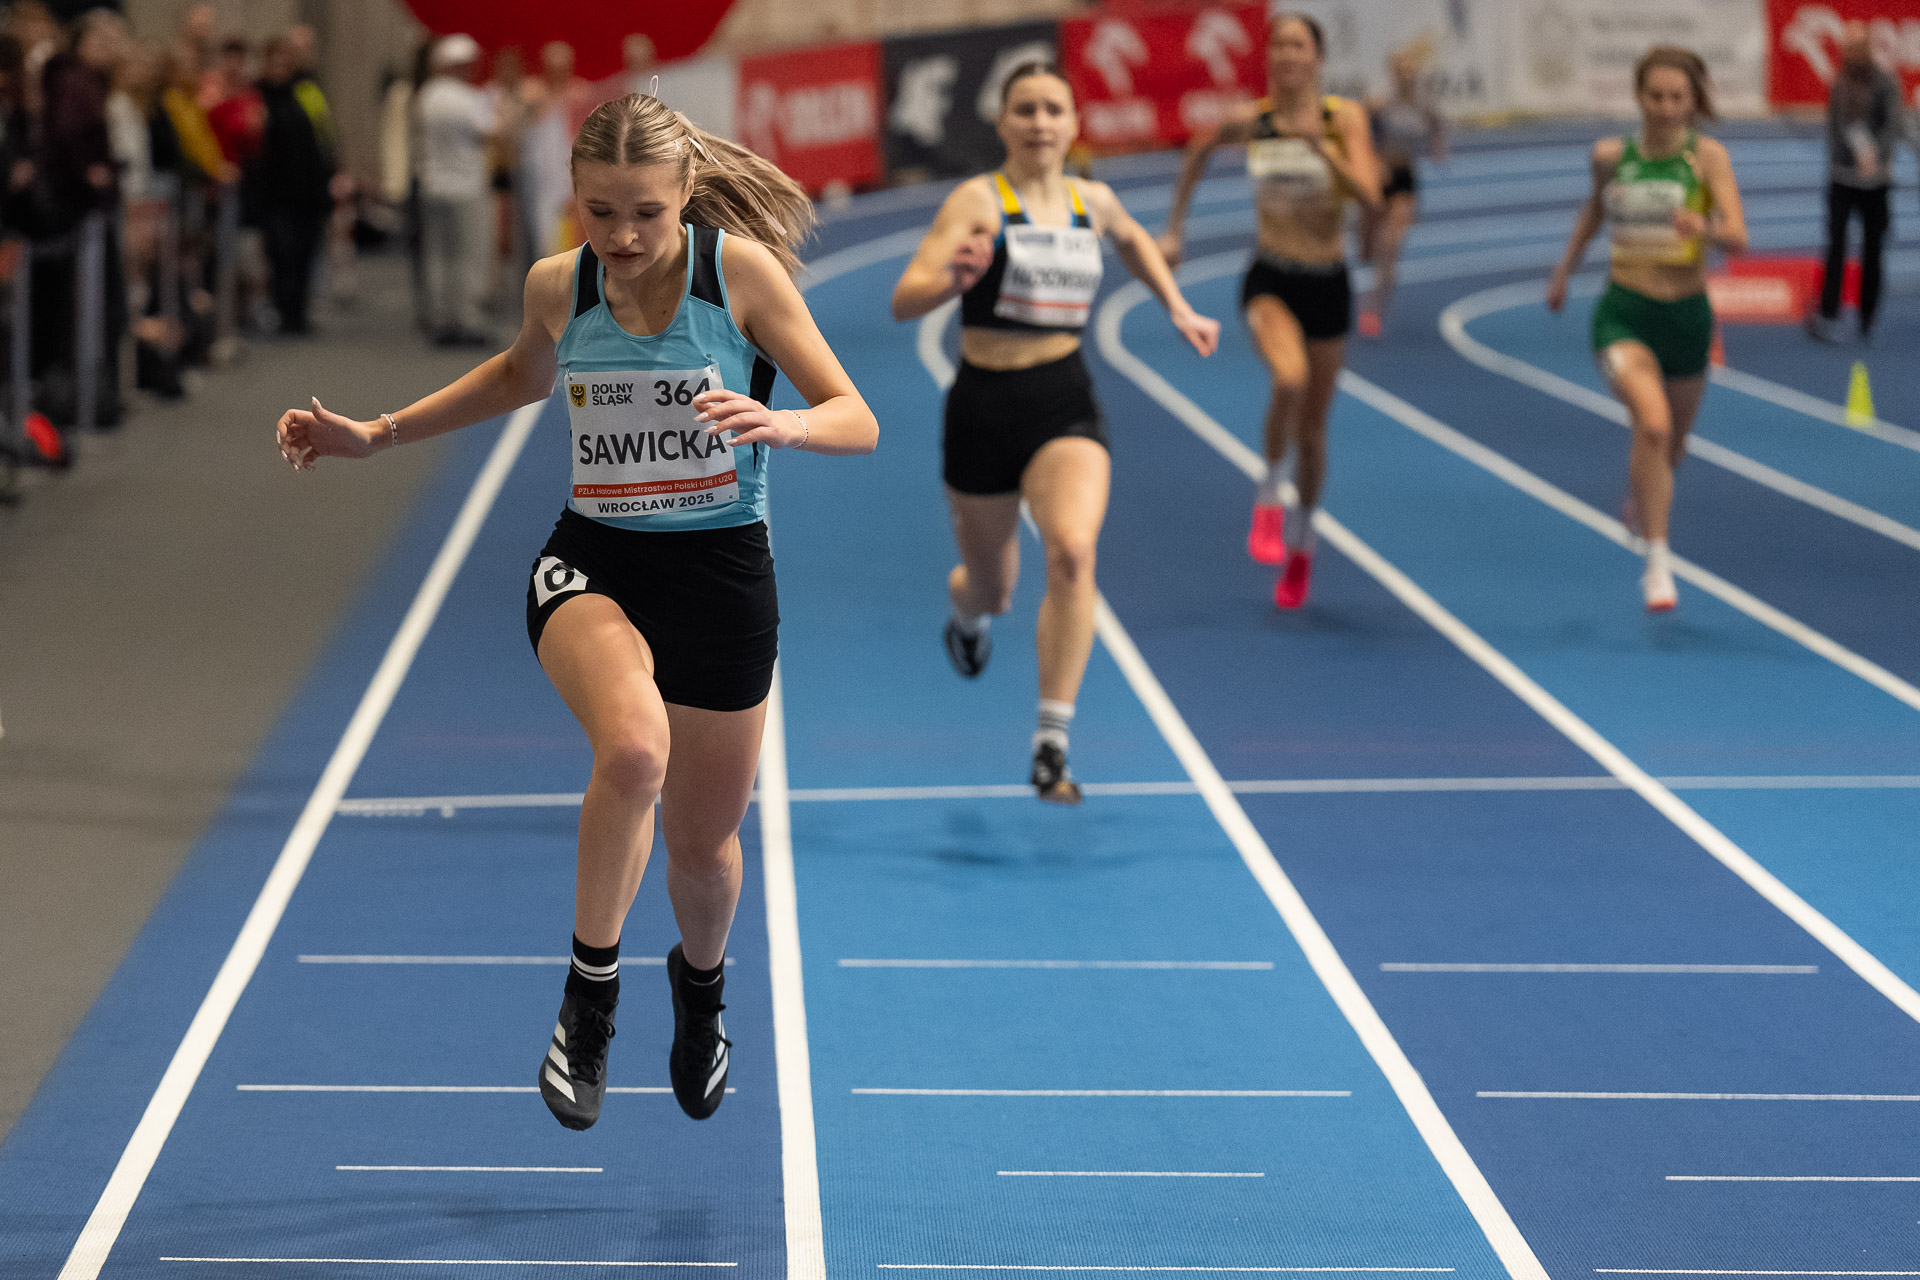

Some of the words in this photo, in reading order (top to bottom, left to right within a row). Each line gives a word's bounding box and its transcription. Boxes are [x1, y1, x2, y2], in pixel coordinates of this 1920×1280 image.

[592, 383, 634, 394] DOLNY
[592, 393, 633, 406] ŚLĄSK
[579, 430, 727, 465] SAWICKA
[578, 487, 595, 495] PZLA
[596, 487, 622, 495] Halowe
[624, 484, 672, 494] Mistrzostwa
[674, 481, 698, 490] Polski
[700, 479, 713, 488] U18
[719, 474, 733, 484] U20
[598, 498, 675, 513] WROCŁAW
[679, 493, 714, 507] 2025
